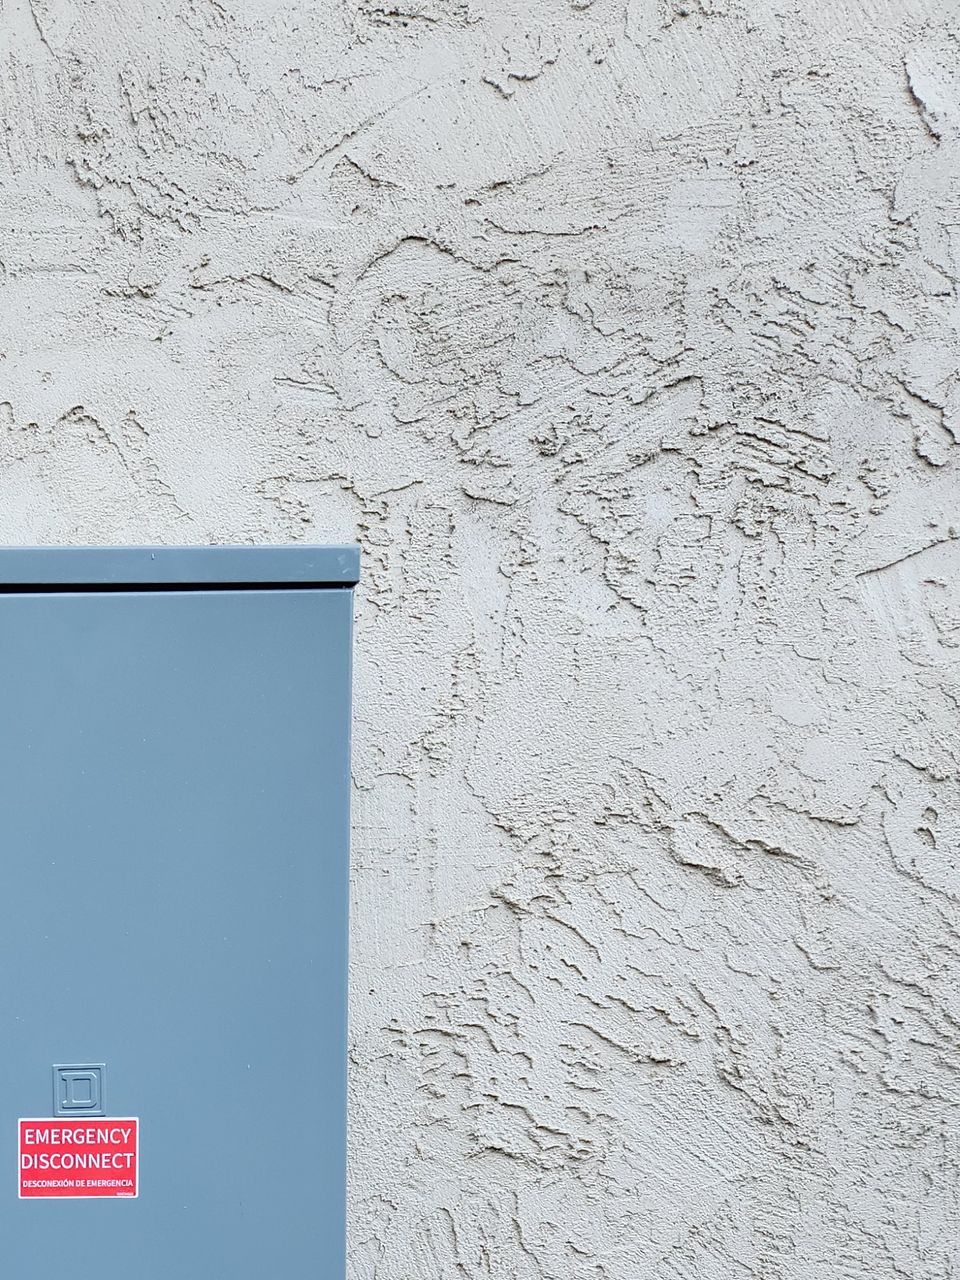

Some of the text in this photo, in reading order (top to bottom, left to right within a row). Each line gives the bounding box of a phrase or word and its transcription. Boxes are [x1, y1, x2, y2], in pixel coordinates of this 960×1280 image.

[24, 1128, 132, 1145] EMERGENCY
[21, 1153, 135, 1170] DISCONNECT
[22, 1178, 75, 1188] DESCONEXIÓN
[86, 1179, 134, 1188] EMERGENCIA
